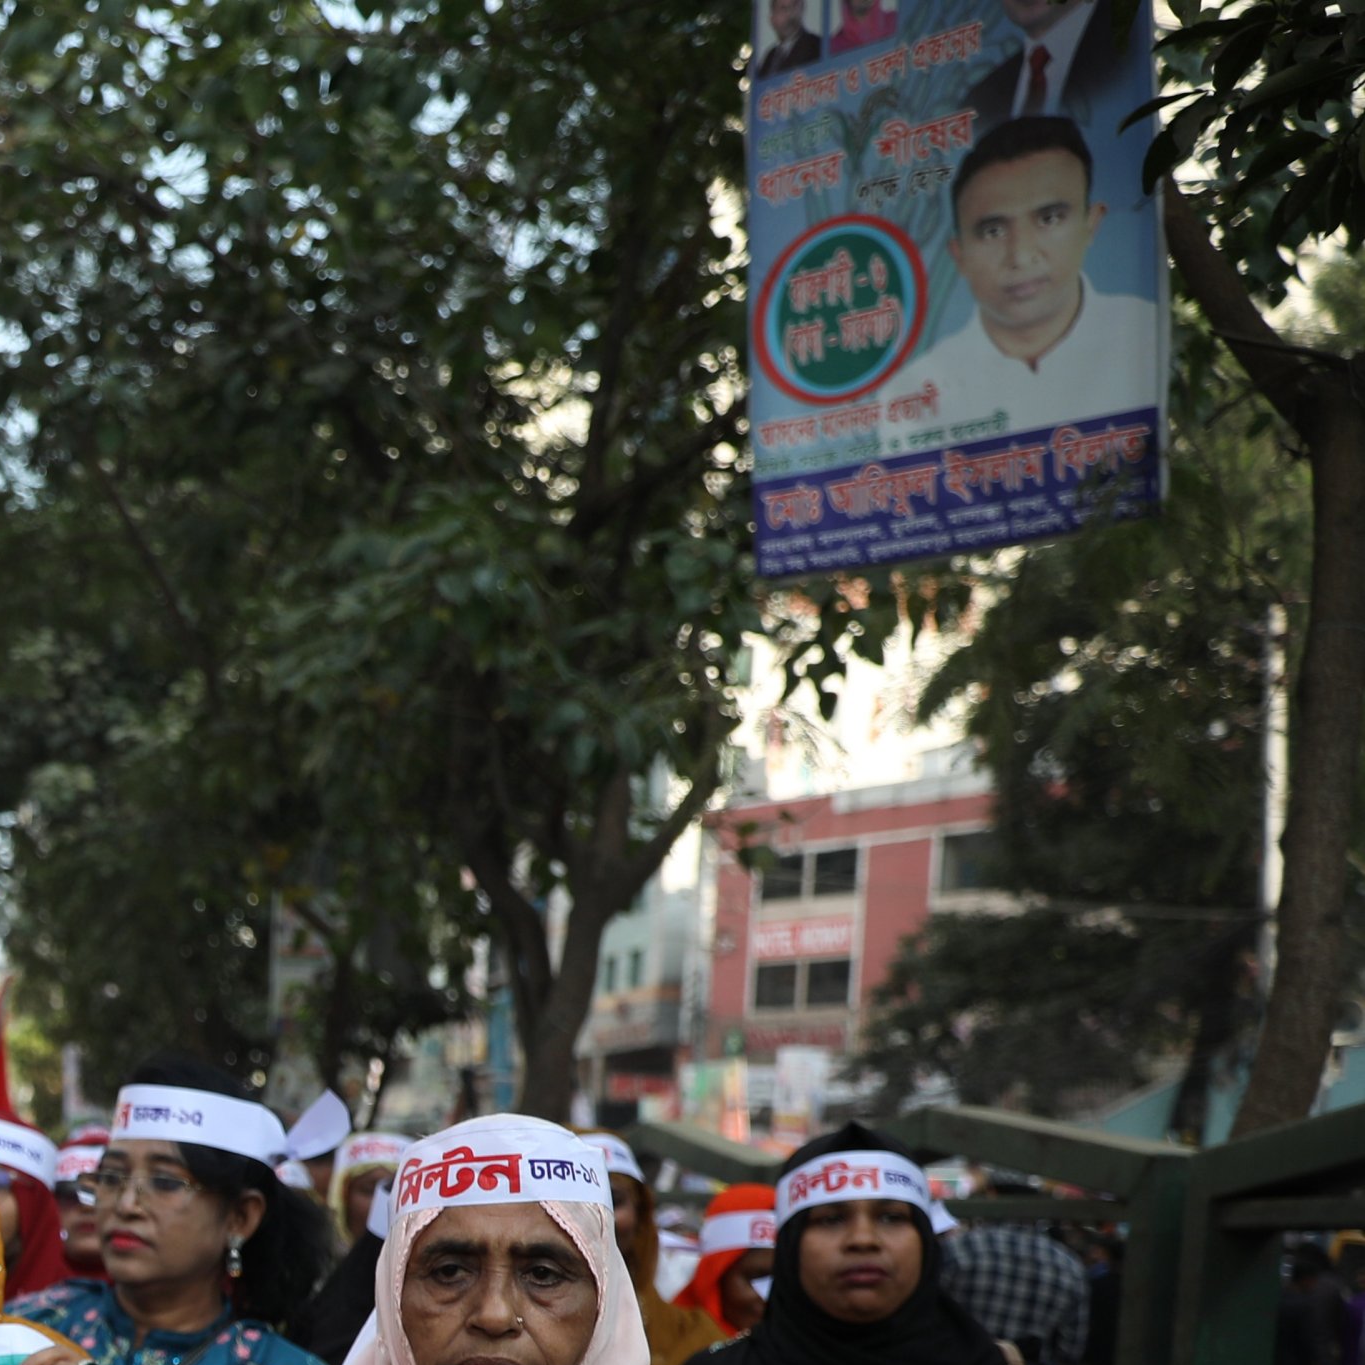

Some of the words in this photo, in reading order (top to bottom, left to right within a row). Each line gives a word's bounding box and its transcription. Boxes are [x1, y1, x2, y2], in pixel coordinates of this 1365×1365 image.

[874, 109, 978, 166] শীষের
[942, 447, 1048, 500] ইসলাম
[132, 1103, 204, 1129] ঢাকা-১৫
[396, 1146, 523, 1212] মিল্টন
[527, 1158, 601, 1189] ঢাকা-১৫
[787, 1161, 880, 1206] মিল্টন
